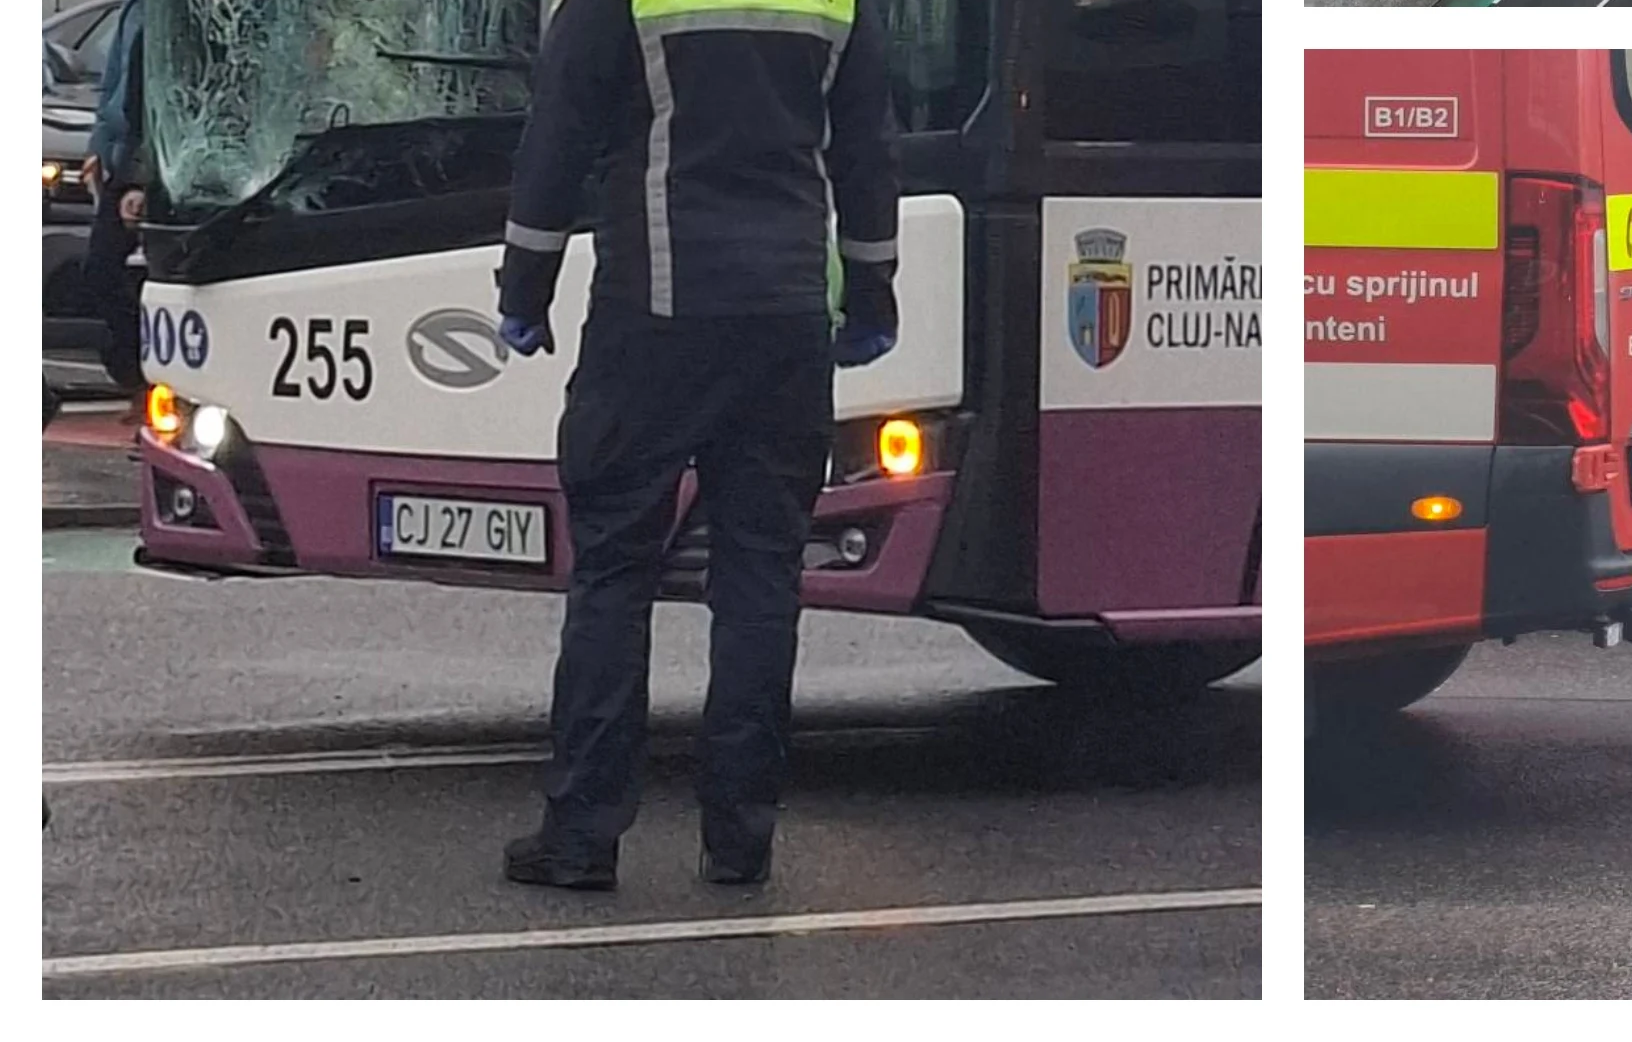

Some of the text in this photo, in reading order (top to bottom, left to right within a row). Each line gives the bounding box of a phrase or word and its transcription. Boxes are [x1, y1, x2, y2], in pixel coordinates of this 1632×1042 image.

[1374, 106, 1449, 128] B1/B2
[1345, 269, 1479, 305] sprijinul
[1146, 311, 1262, 349] CLUJ-NA
[1306, 315, 1387, 343] nteni
[269, 316, 373, 401] 255
[396, 503, 533, 556] CJ 27 GIY
